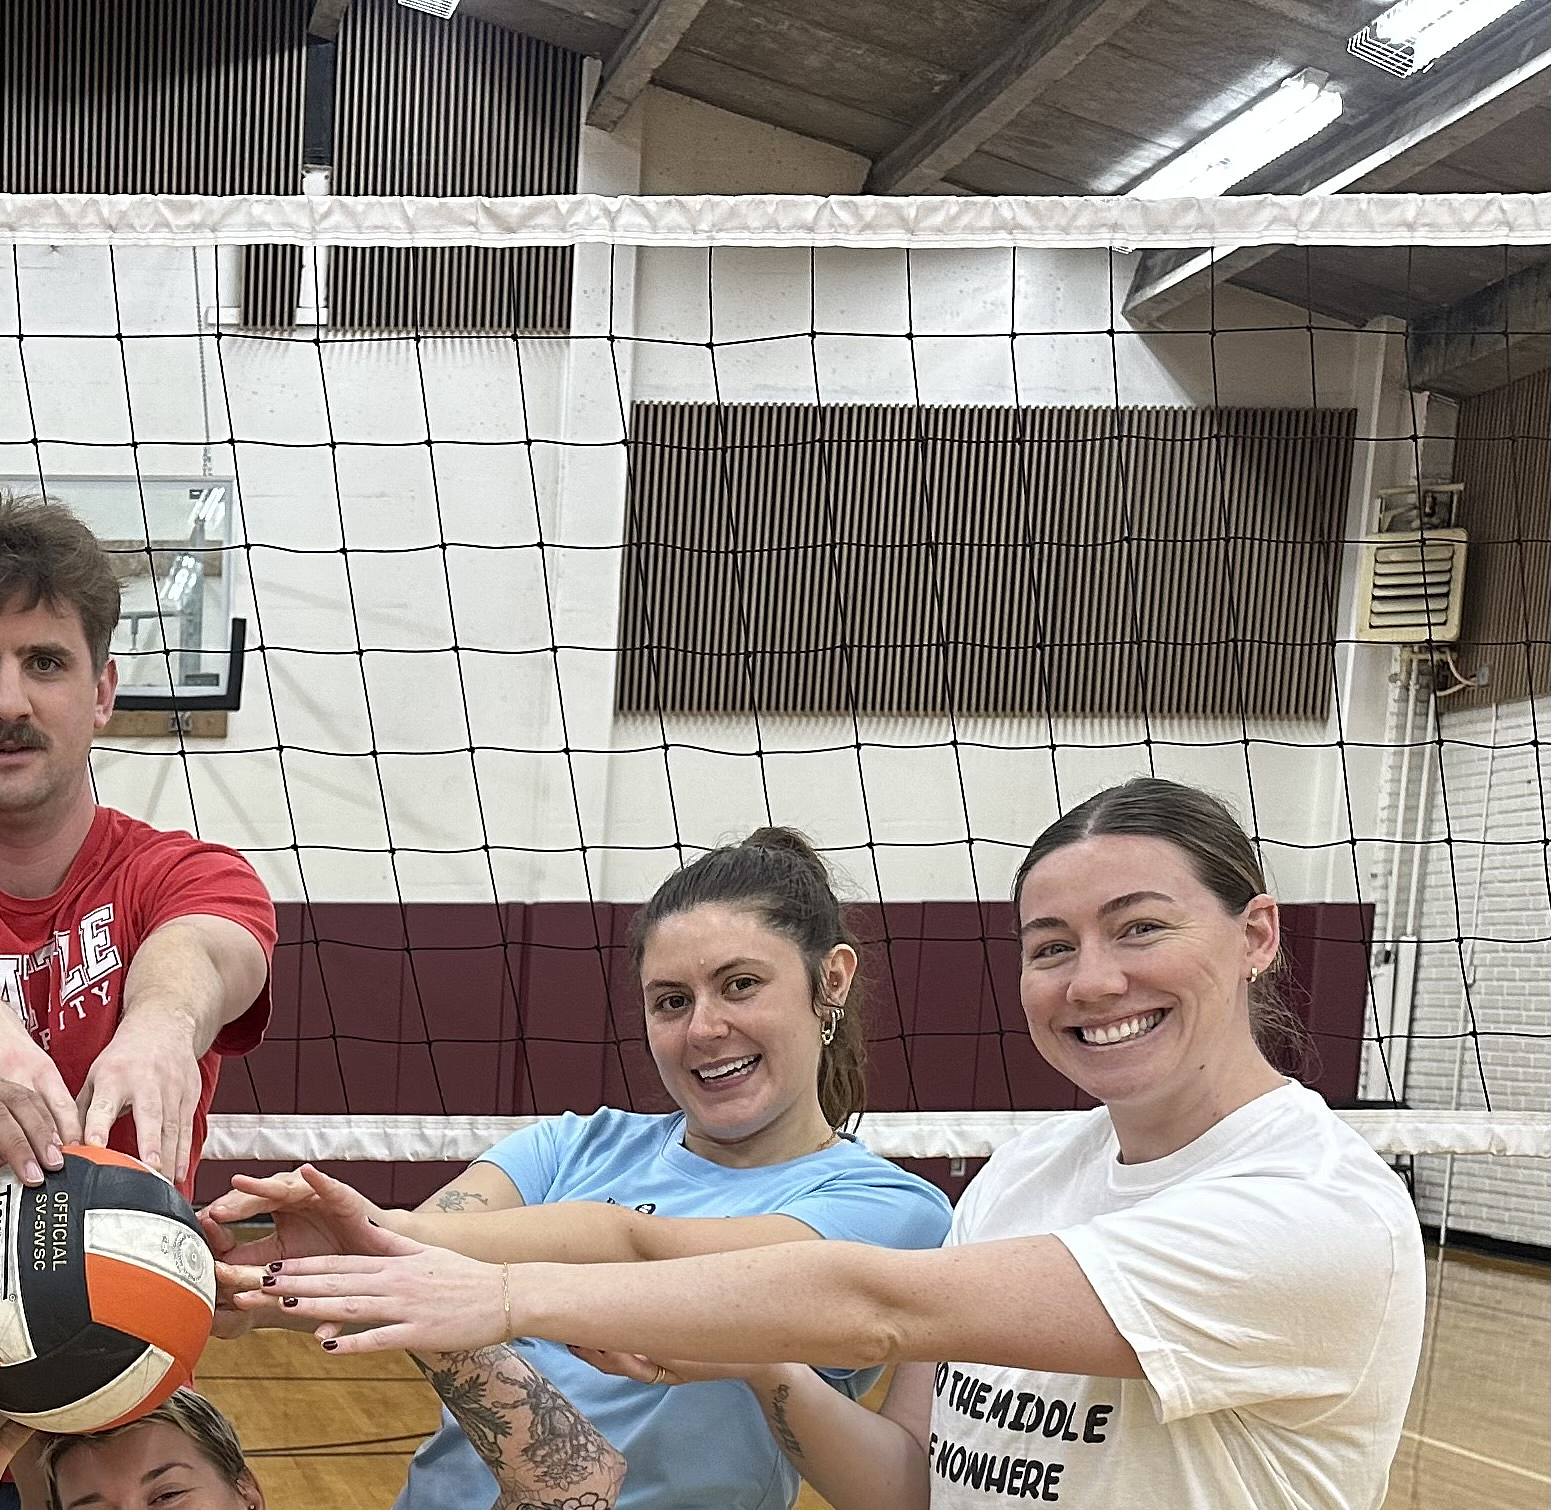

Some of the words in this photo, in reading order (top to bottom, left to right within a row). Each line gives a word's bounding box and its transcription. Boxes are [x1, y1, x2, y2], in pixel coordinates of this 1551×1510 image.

[33, 1193, 48, 1271] SV-5WSC
[52, 1191, 69, 1272] OFFICIAL
[948, 1370, 993, 1420] THE
[935, 1440, 1065, 1501] NOWHERE
